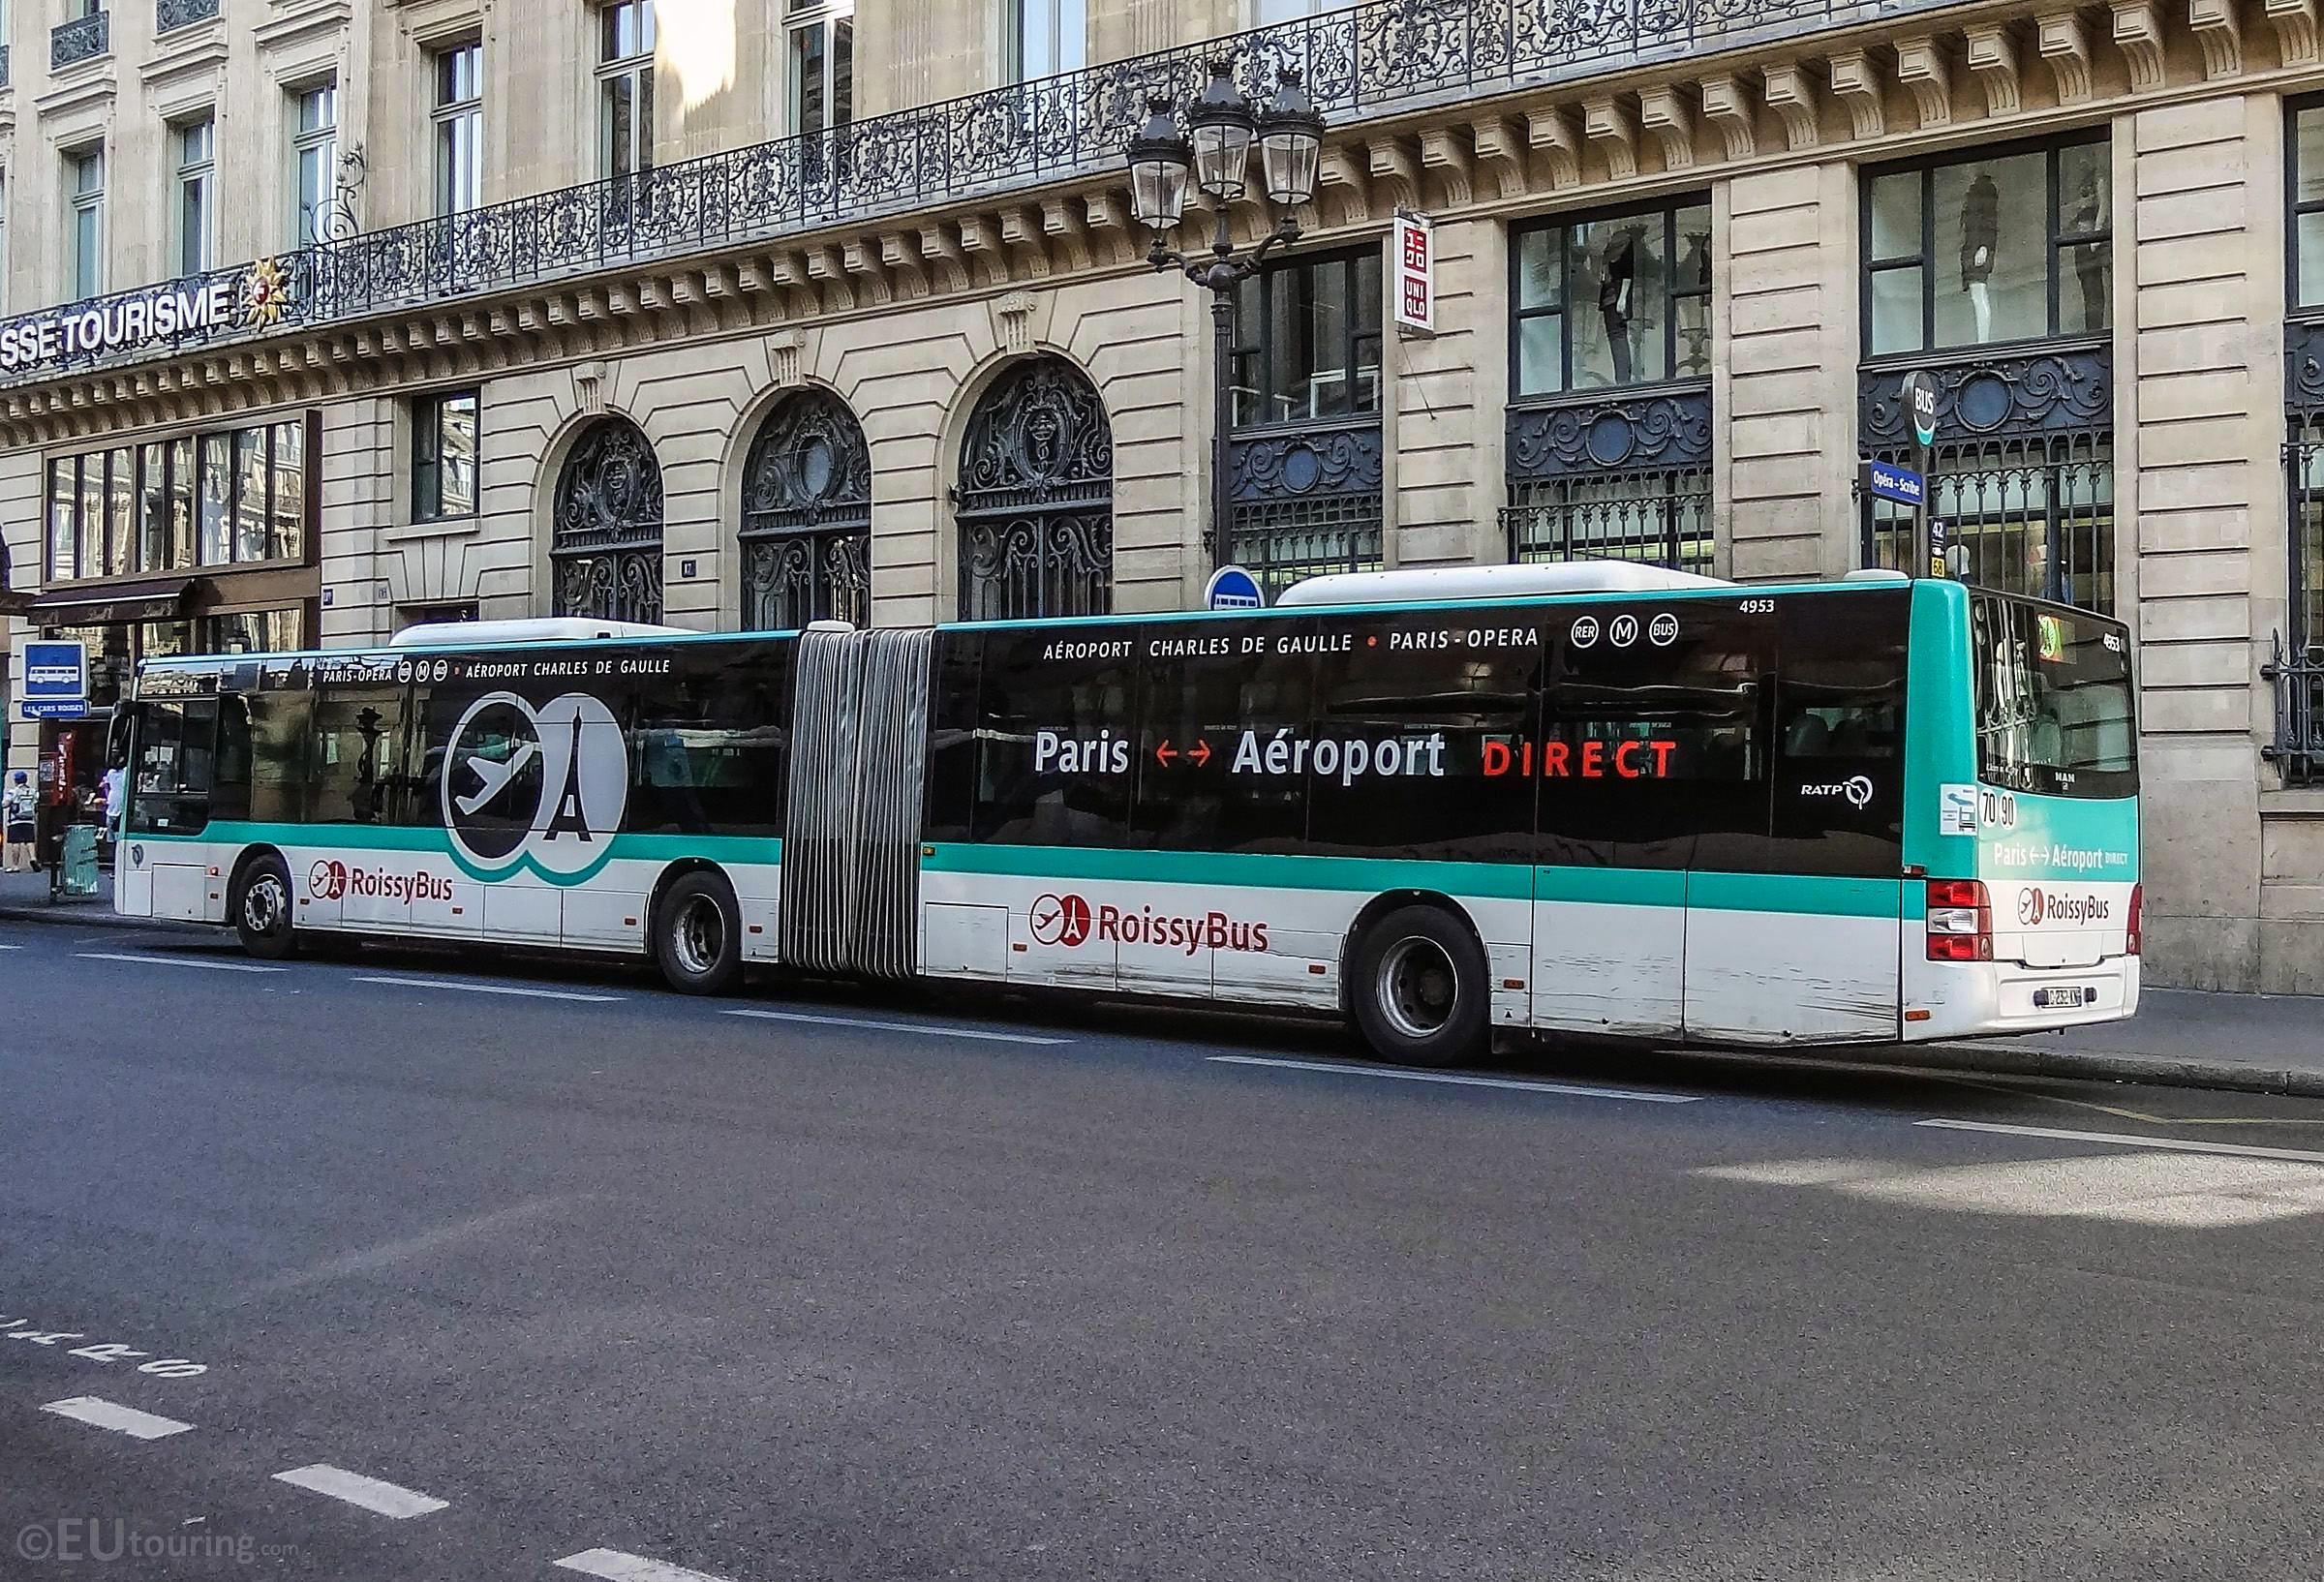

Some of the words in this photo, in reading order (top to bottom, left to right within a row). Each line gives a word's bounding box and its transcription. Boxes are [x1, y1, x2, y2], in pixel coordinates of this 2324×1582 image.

[1406, 281, 1424, 299] UNI
[1406, 298, 1425, 316] QLO
[0, 319, 56, 366] SSE
[62, 283, 230, 352] TOURISME
[1914, 387, 1934, 414] BUS
[1933, 522, 1943, 537] 42
[1934, 560, 1942, 575] 68
[1739, 599, 1774, 614] 4953
[1043, 640, 1132, 659] AÉROPORT
[1149, 638, 1230, 656] CHARLES
[1241, 637, 1265, 654] DE
[1277, 634, 1352, 654] GAULLE
[1390, 630, 1449, 650] PARIS
[1467, 628, 1539, 647] OPERA
[1574, 626, 1597, 639] RER
[1615, 623, 1633, 639] M
[1652, 623, 1675, 637] BUS
[466, 663, 528, 678] AÉROPORT
[534, 661, 588, 676] CHARLES
[596, 660, 612, 674] DE
[620, 659, 670, 673] GAULLE
[1034, 729, 1128, 773] Paris
[1232, 728, 1444, 786] Aéroport
[1483, 741, 1676, 776] DIRECT
[1801, 785, 1843, 795] RATP
[2055, 772, 2075, 782] MAN
[1982, 792, 1996, 823] 70
[2002, 796, 2013, 826] 90
[1994, 843, 2027, 866] Paris
[2052, 844, 2103, 872] Aéroport
[2105, 853, 2128, 866] DIRECT
[352, 867, 452, 905] RoissyBus
[2047, 893, 2109, 926] RoissyBus
[1099, 904, 1268, 956] RoissyBus
